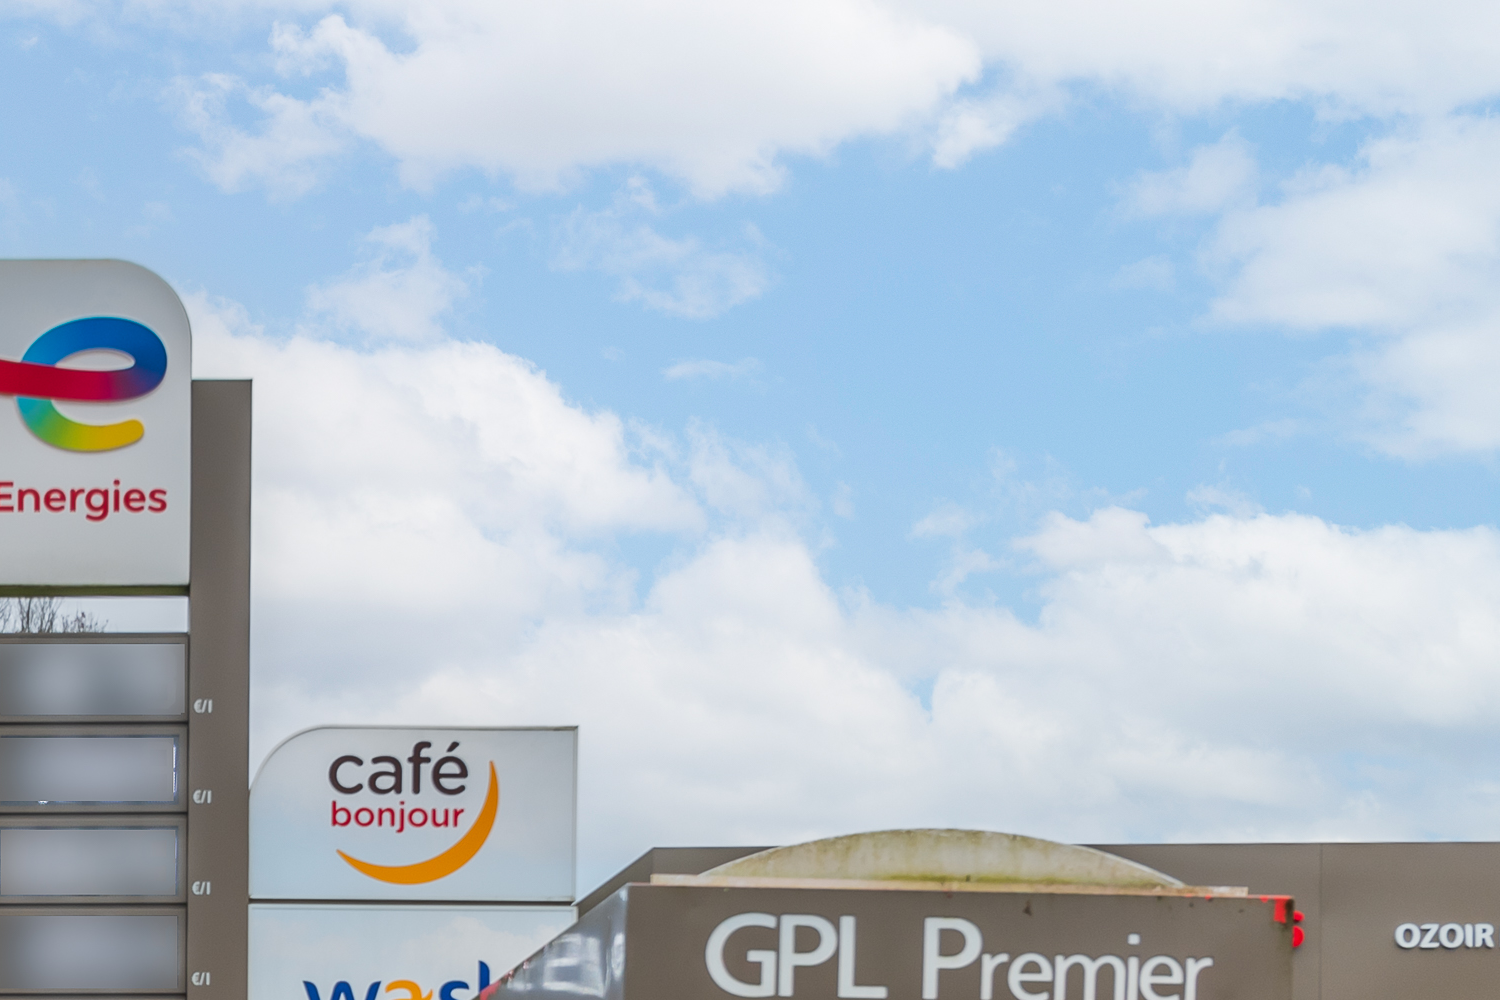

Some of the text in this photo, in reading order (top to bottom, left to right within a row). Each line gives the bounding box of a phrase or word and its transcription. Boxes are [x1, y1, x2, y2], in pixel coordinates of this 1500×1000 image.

[328, 740, 468, 795] café
[331, 801, 465, 833] bonjour
[704, 913, 887, 999] GPL
[1395, 922, 1495, 948] OZOIR
